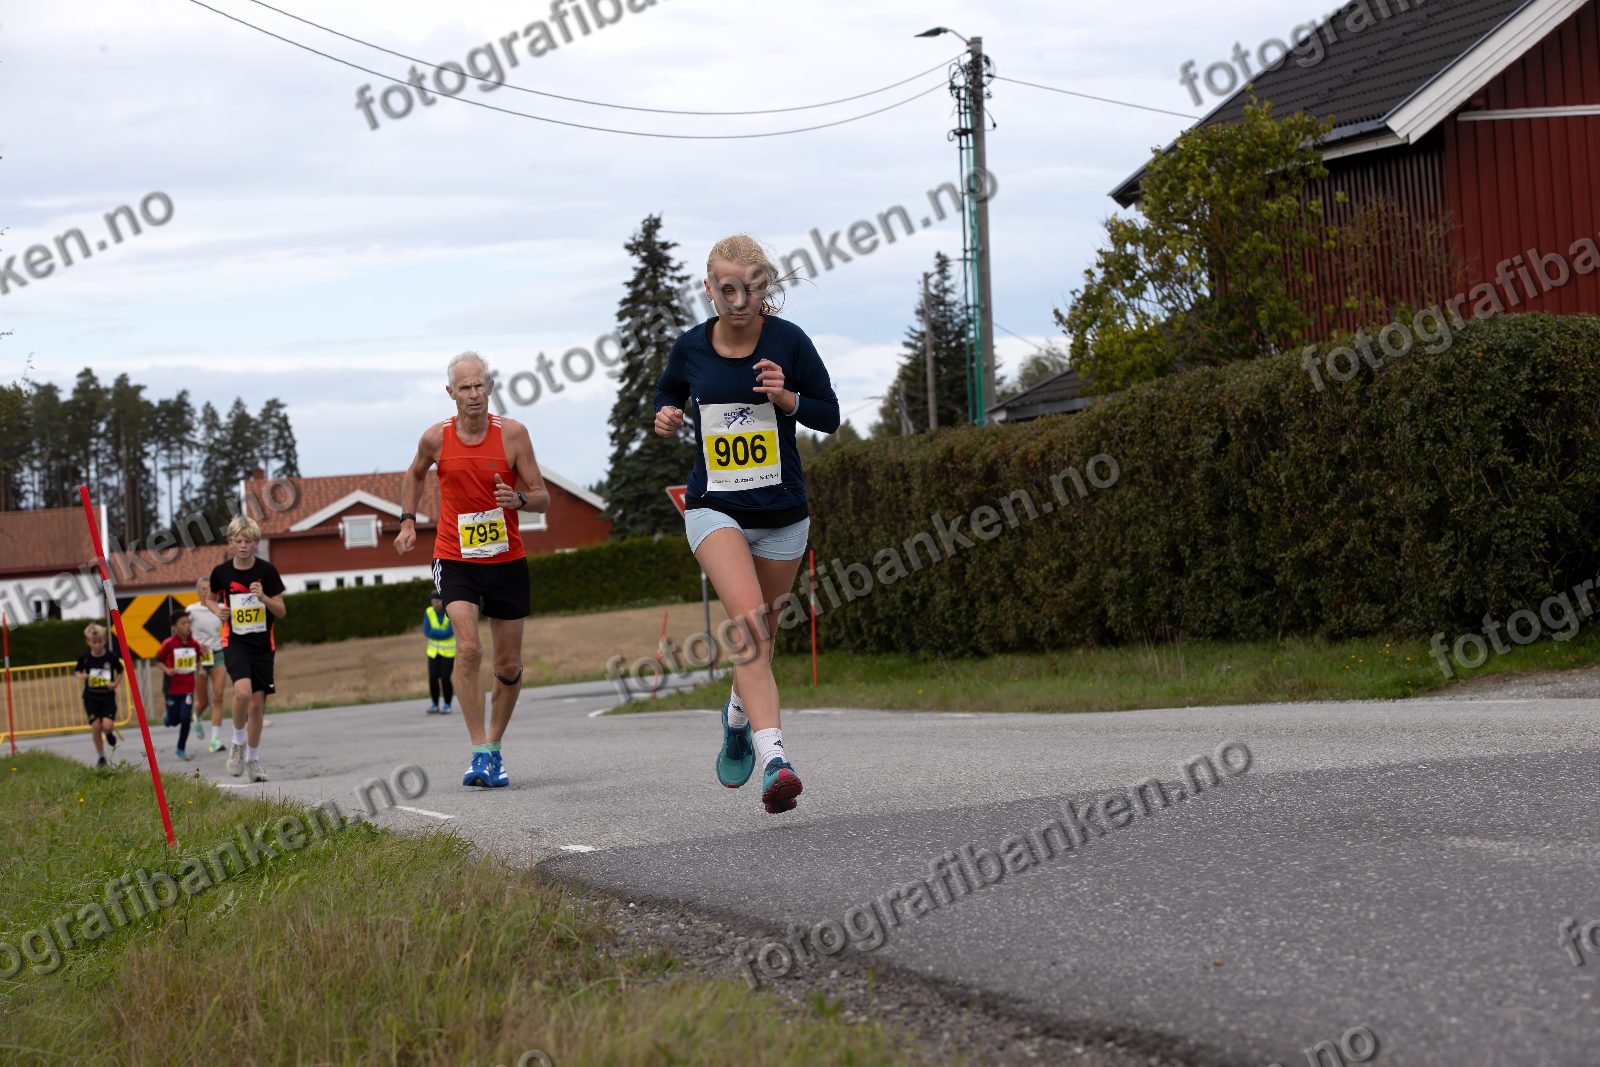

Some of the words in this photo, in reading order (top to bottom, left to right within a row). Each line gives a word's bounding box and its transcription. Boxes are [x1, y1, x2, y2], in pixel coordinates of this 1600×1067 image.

[714, 434, 767, 467] 906
[465, 522, 500, 545] 795
[236, 608, 260, 623] 857
